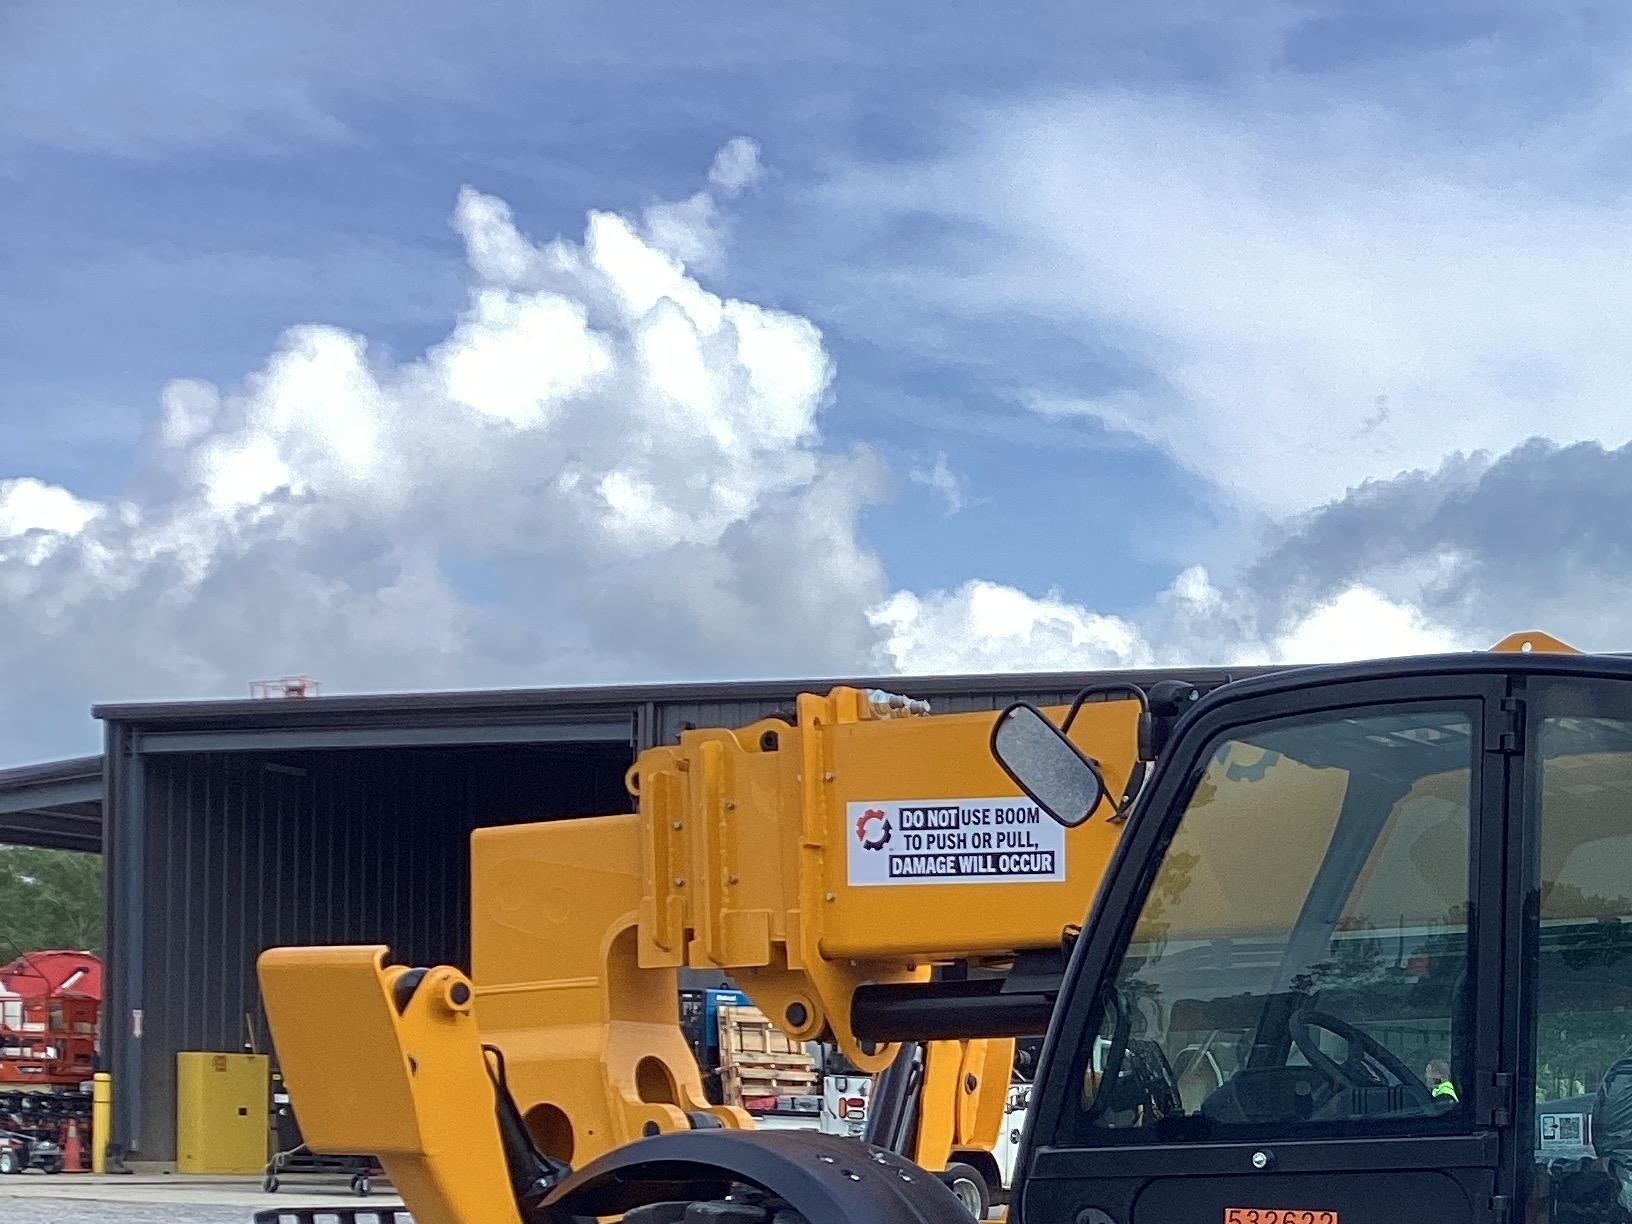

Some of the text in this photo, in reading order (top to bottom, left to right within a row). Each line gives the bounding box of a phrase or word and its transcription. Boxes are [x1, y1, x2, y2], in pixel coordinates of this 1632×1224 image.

[902, 807, 1040, 828] DO NOT USE BOOM
[904, 830, 1039, 850] TO PUSH OR PULL,
[892, 853, 1052, 875] DAMAGE WILL OCCUR
